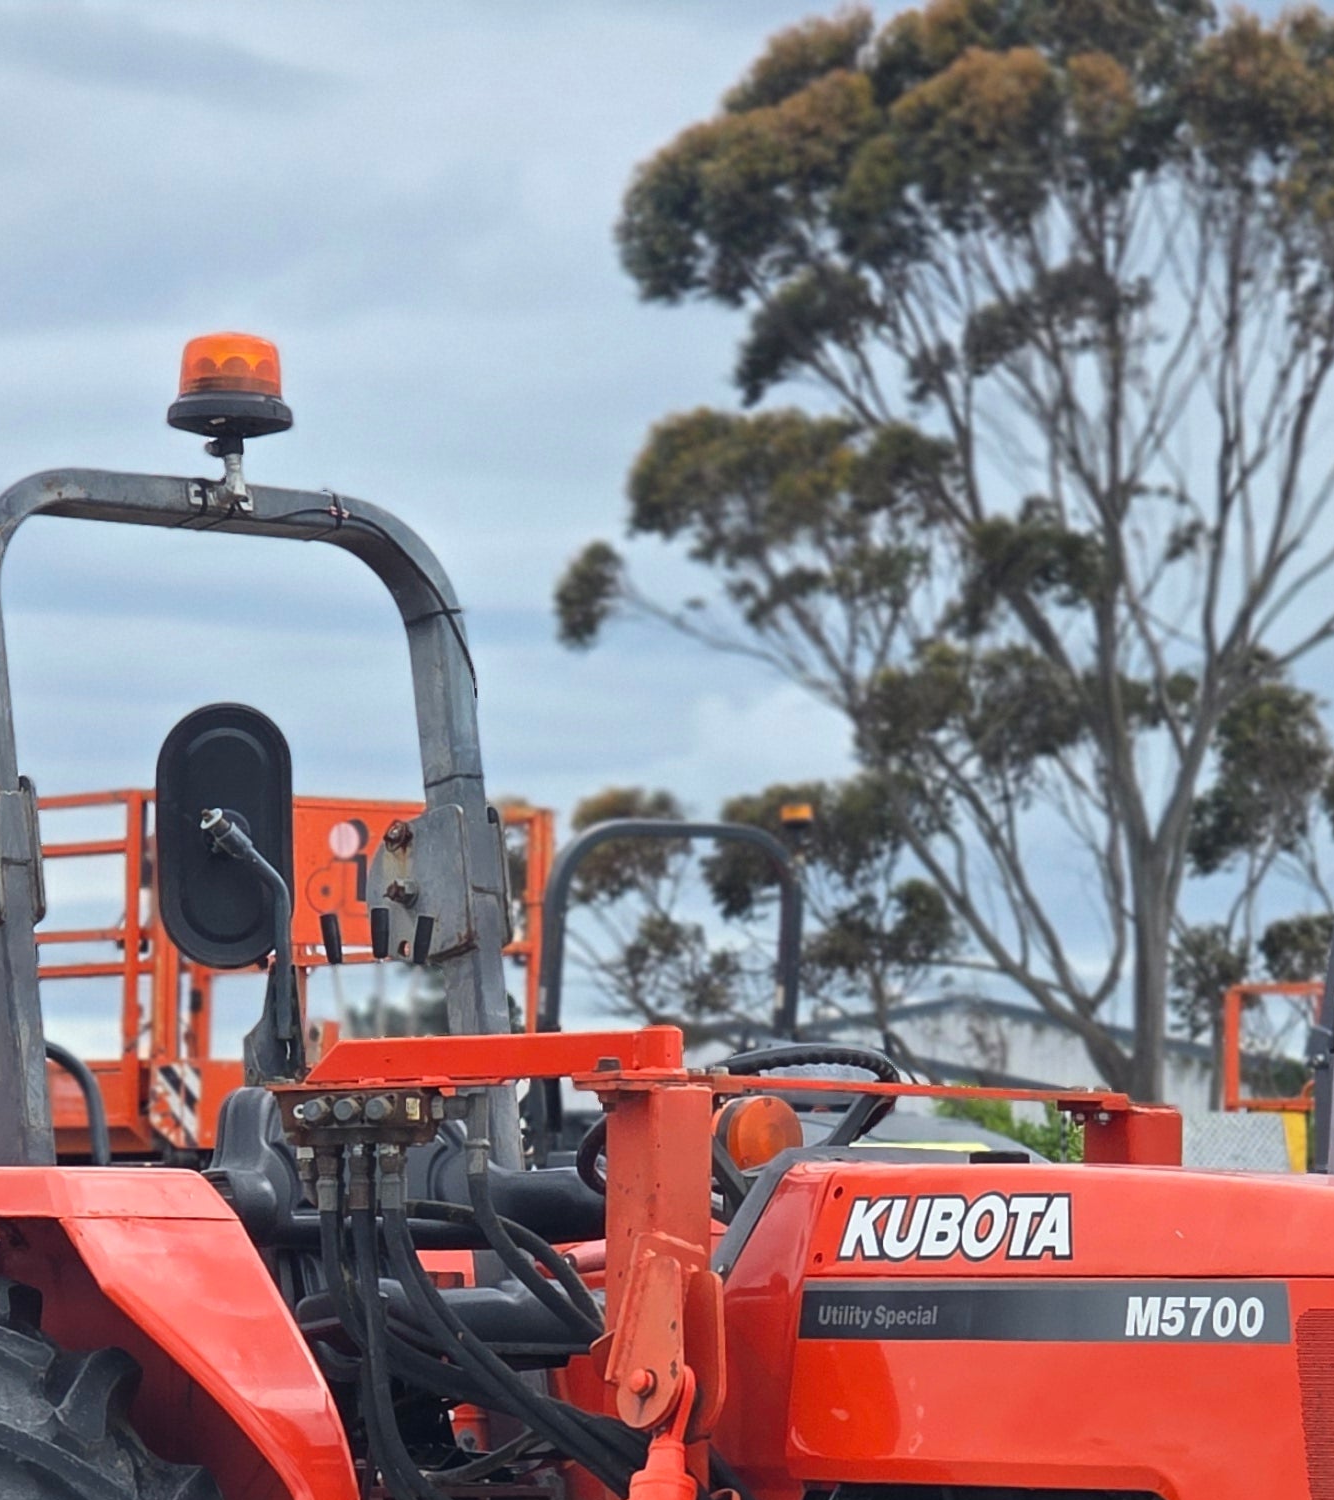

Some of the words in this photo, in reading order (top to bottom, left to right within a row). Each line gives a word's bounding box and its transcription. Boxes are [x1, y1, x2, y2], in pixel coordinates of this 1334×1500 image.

[837, 1190, 1073, 1263] KUBOTA
[818, 1305, 870, 1329] Utility
[874, 1304, 939, 1329] Special
[1125, 1296, 1265, 1338] M5700
